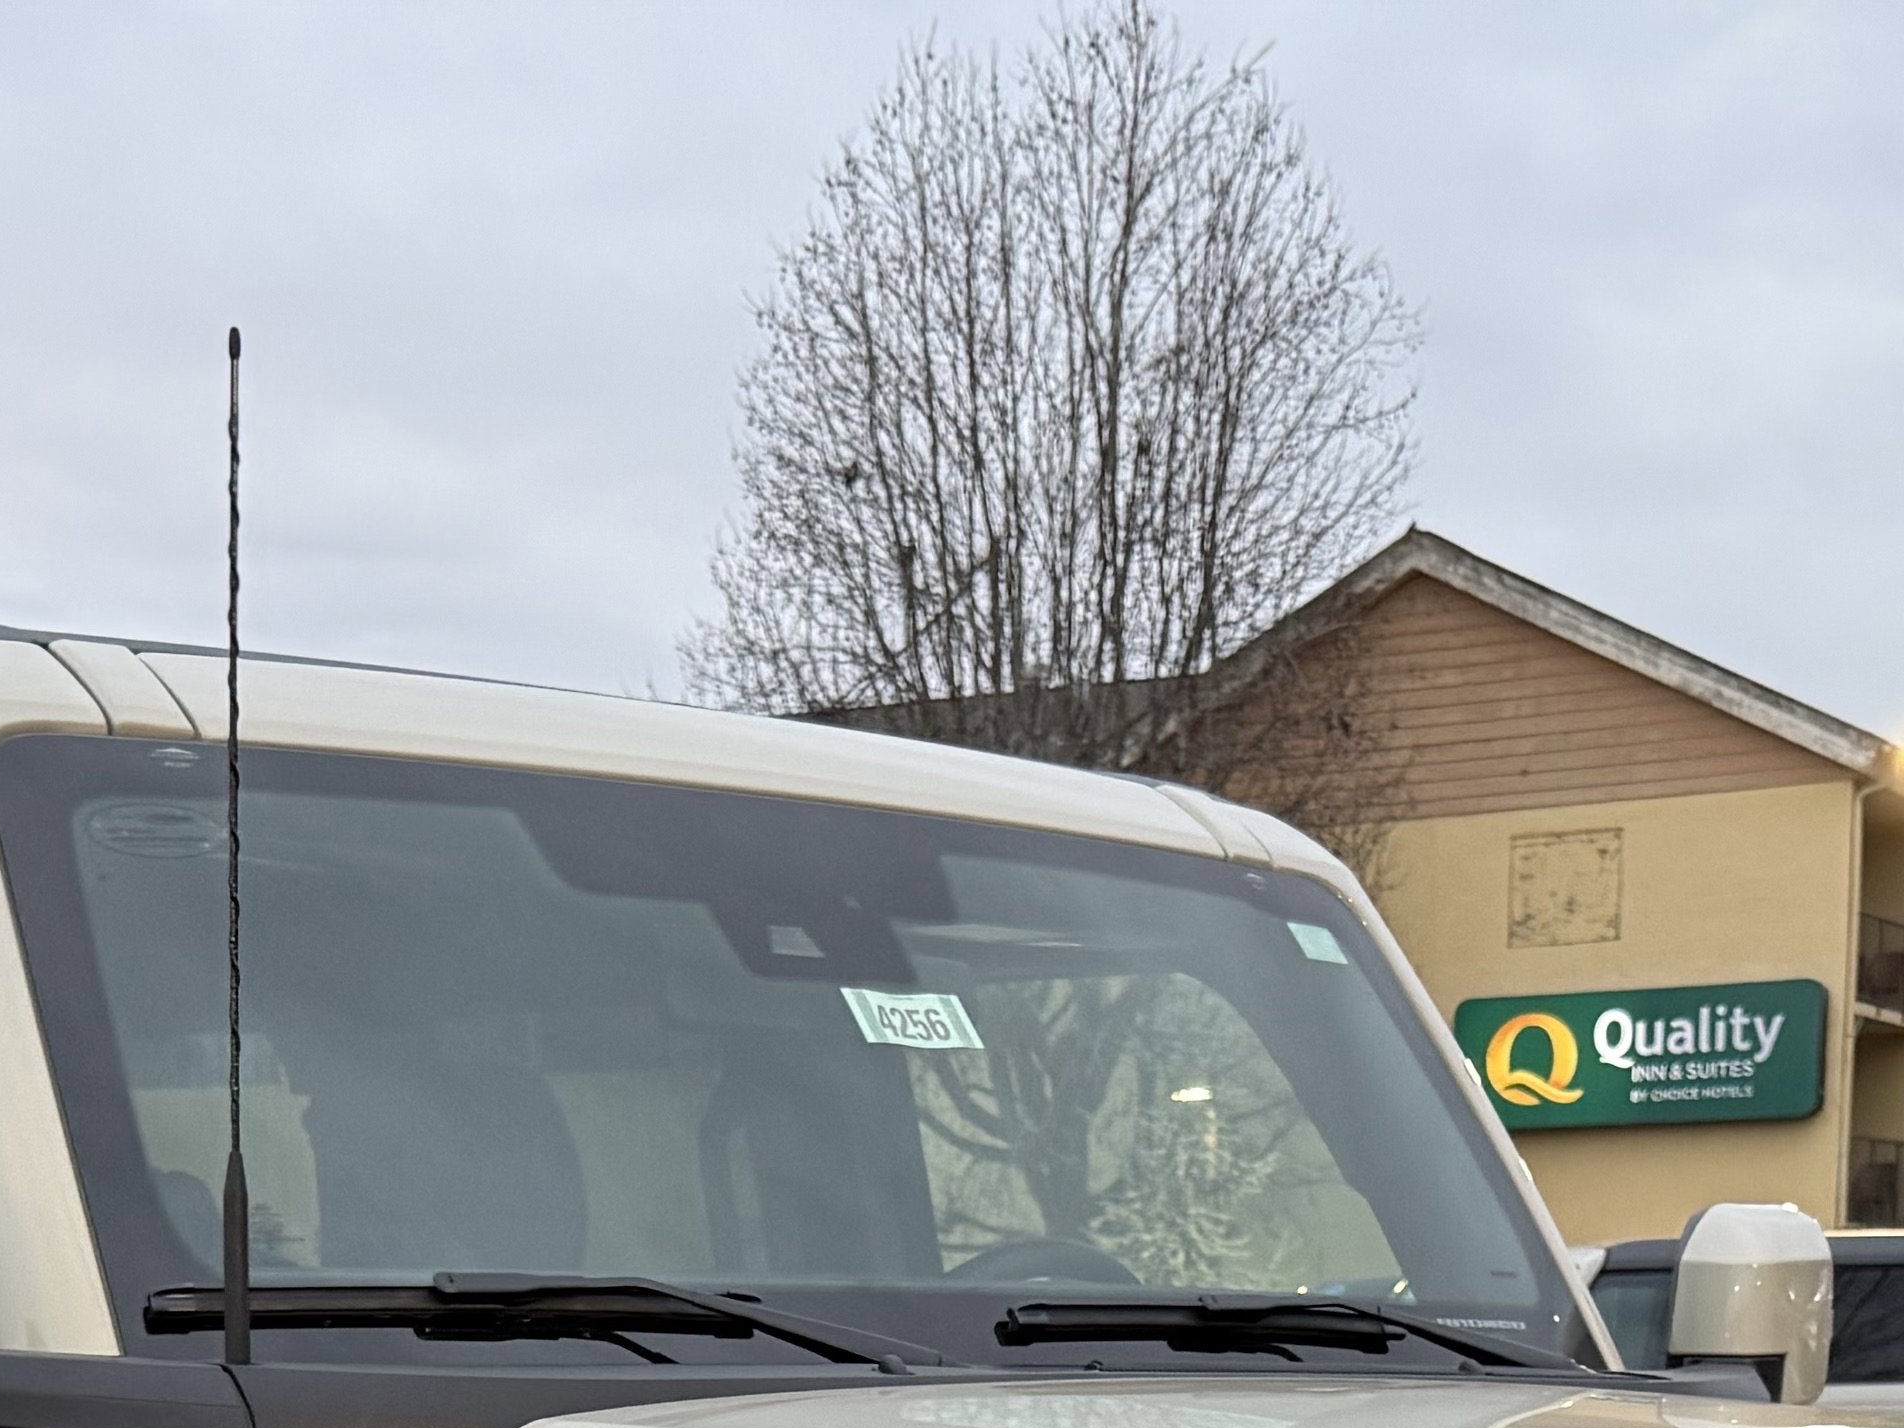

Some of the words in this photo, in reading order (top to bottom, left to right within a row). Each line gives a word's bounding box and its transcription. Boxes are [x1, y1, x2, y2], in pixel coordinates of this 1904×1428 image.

[877, 1004, 951, 1041] 4256
[1593, 1003, 1786, 1069] Quality
[1486, 1012, 1584, 1106] Q
[1631, 1063, 1668, 1083] INN
[1668, 1062, 1684, 1081] &
[1685, 1059, 1755, 1080] SUITES
